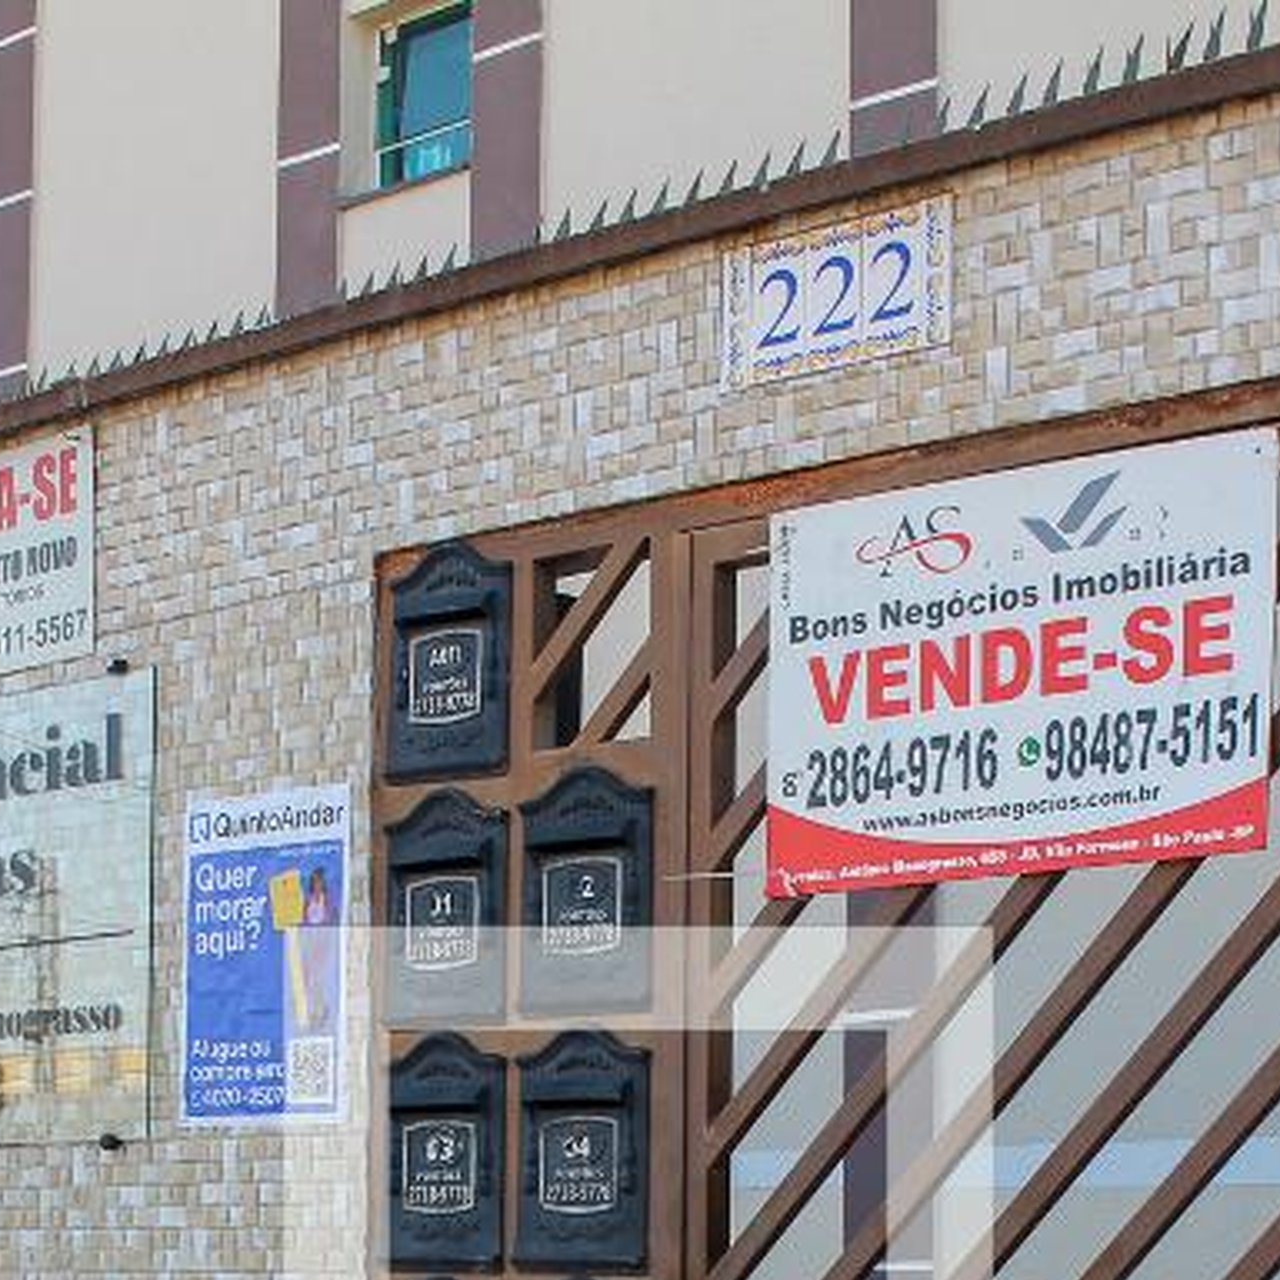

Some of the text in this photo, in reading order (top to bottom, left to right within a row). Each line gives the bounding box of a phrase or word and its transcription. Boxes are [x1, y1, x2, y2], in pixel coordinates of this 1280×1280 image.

[756, 240, 915, 350] 222
[26, 535, 78, 577] NOVO
[788, 547, 1252, 645] Bons Negócios Imobiliária
[808, 594, 1235, 725] VENDE-SE
[806, 693, 1259, 810] 2864-9716 98487-5151
[194, 862, 258, 892] Quer
[194, 893, 268, 925] morar
[194, 920, 262, 961] aqui?
